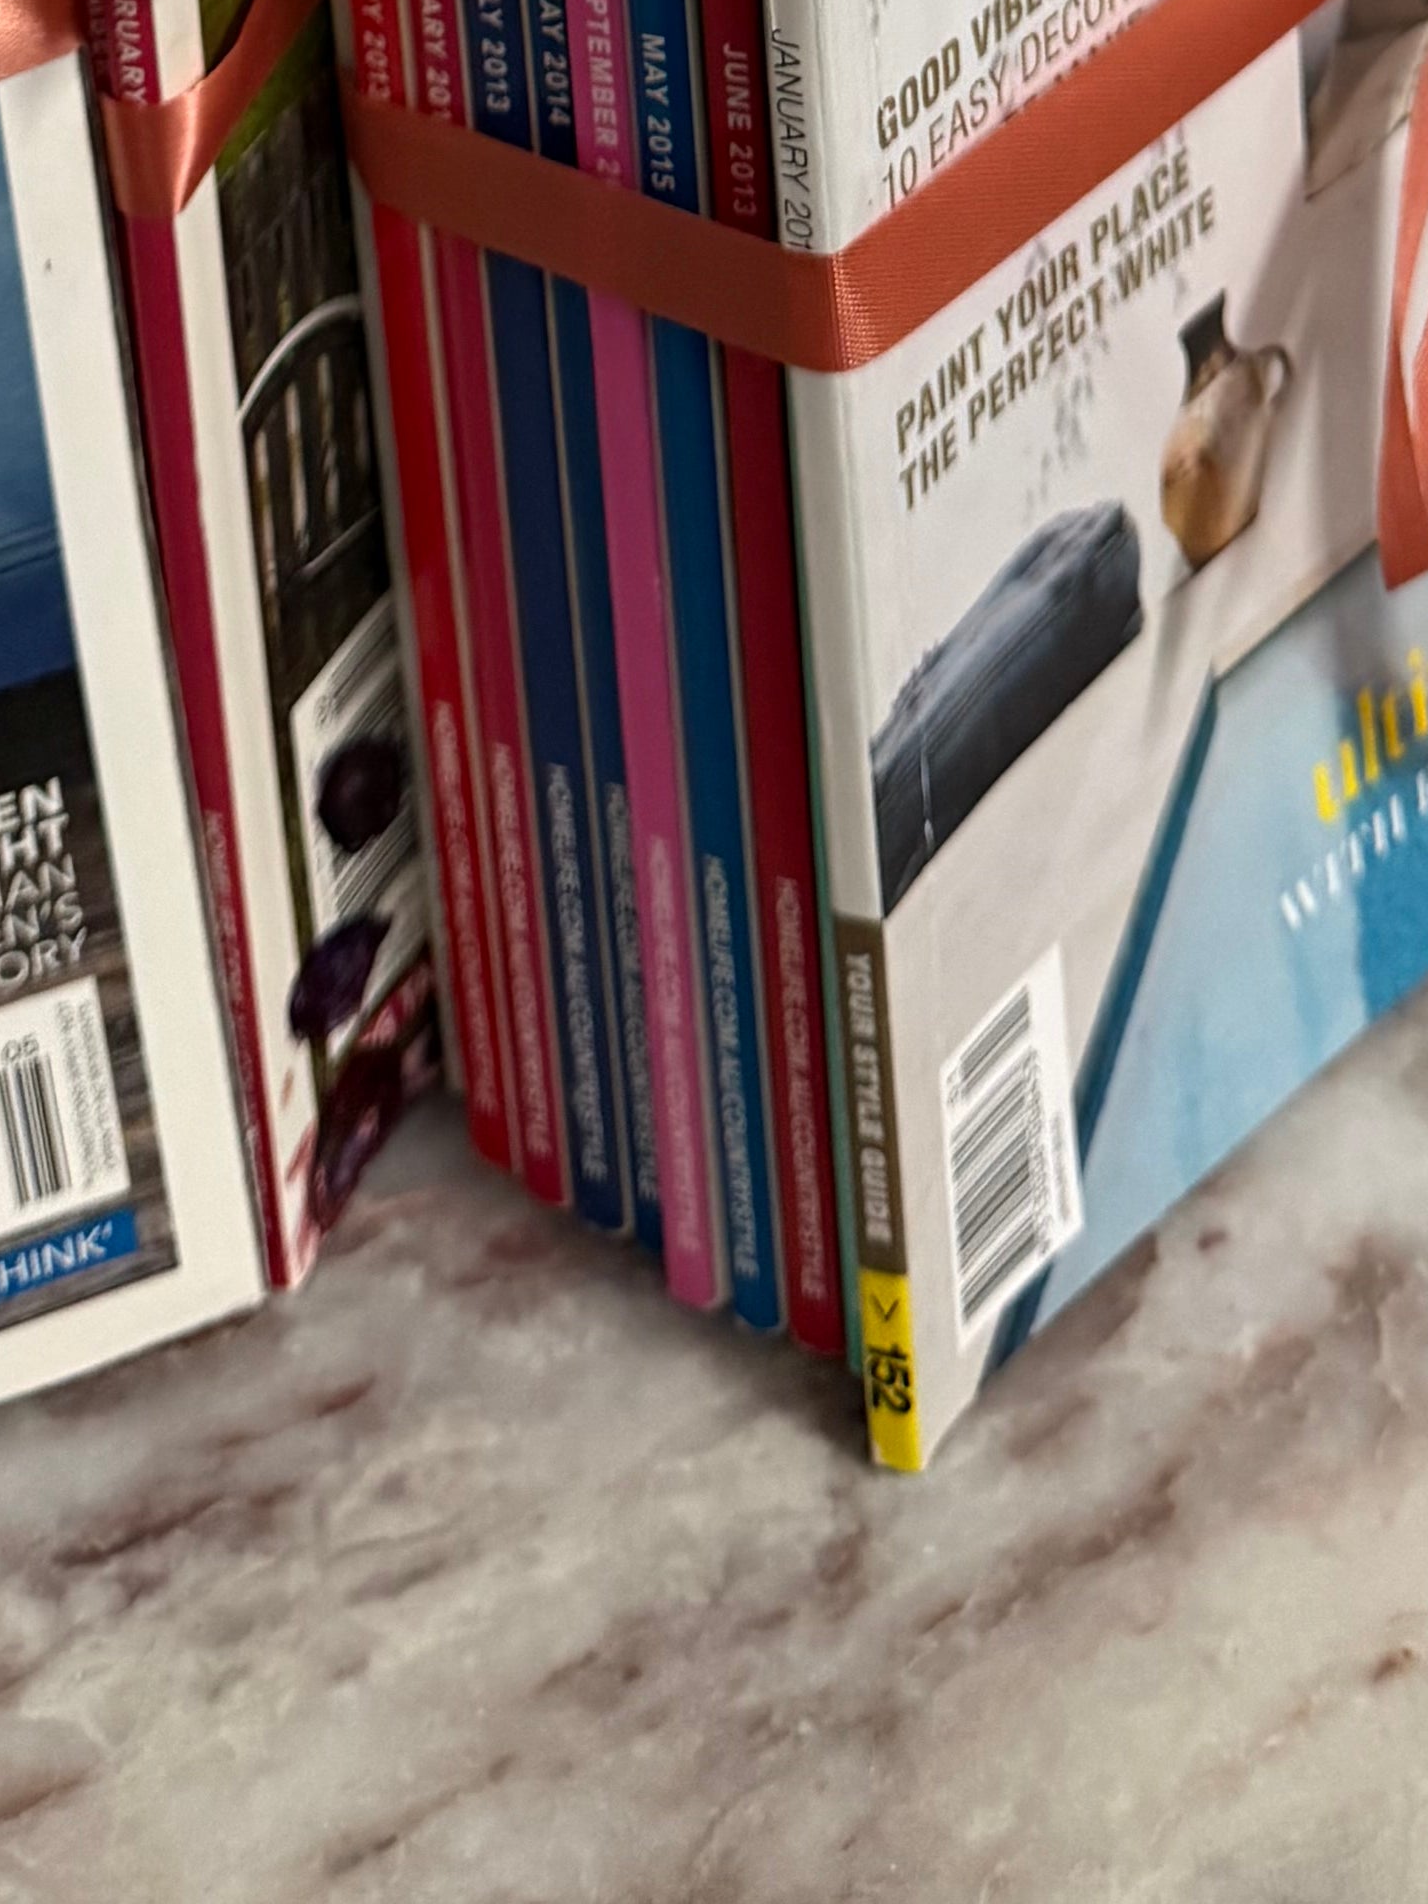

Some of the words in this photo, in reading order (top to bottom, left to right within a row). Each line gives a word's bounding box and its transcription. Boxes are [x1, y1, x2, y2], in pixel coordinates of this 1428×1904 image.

[482, 40, 510, 115] 2013
[544, 54, 572, 127] 2014
[642, 32, 668, 97] MAY
[724, 43, 752, 134] JUNE
[877, 37, 961, 151] GOOD
[772, 27, 809, 195] JANUARY
[882, 145, 918, 210] 10
[928, 50, 1008, 170] EASY
[648, 115, 676, 192] 2015
[729, 145, 758, 218] 2013
[783, 199, 815, 250] 201
[895, 320, 987, 454] PAINT
[996, 240, 1080, 341] YOUR
[1089, 149, 1192, 268] PLACE
[898, 442, 958, 511] THE
[968, 280, 1105, 444] PERFECT
[1118, 187, 1217, 298] WHITE
[846, 953, 875, 1036] YOUR
[851, 1042, 883, 1145] STYLE
[869, 1344, 912, 1416] 152
